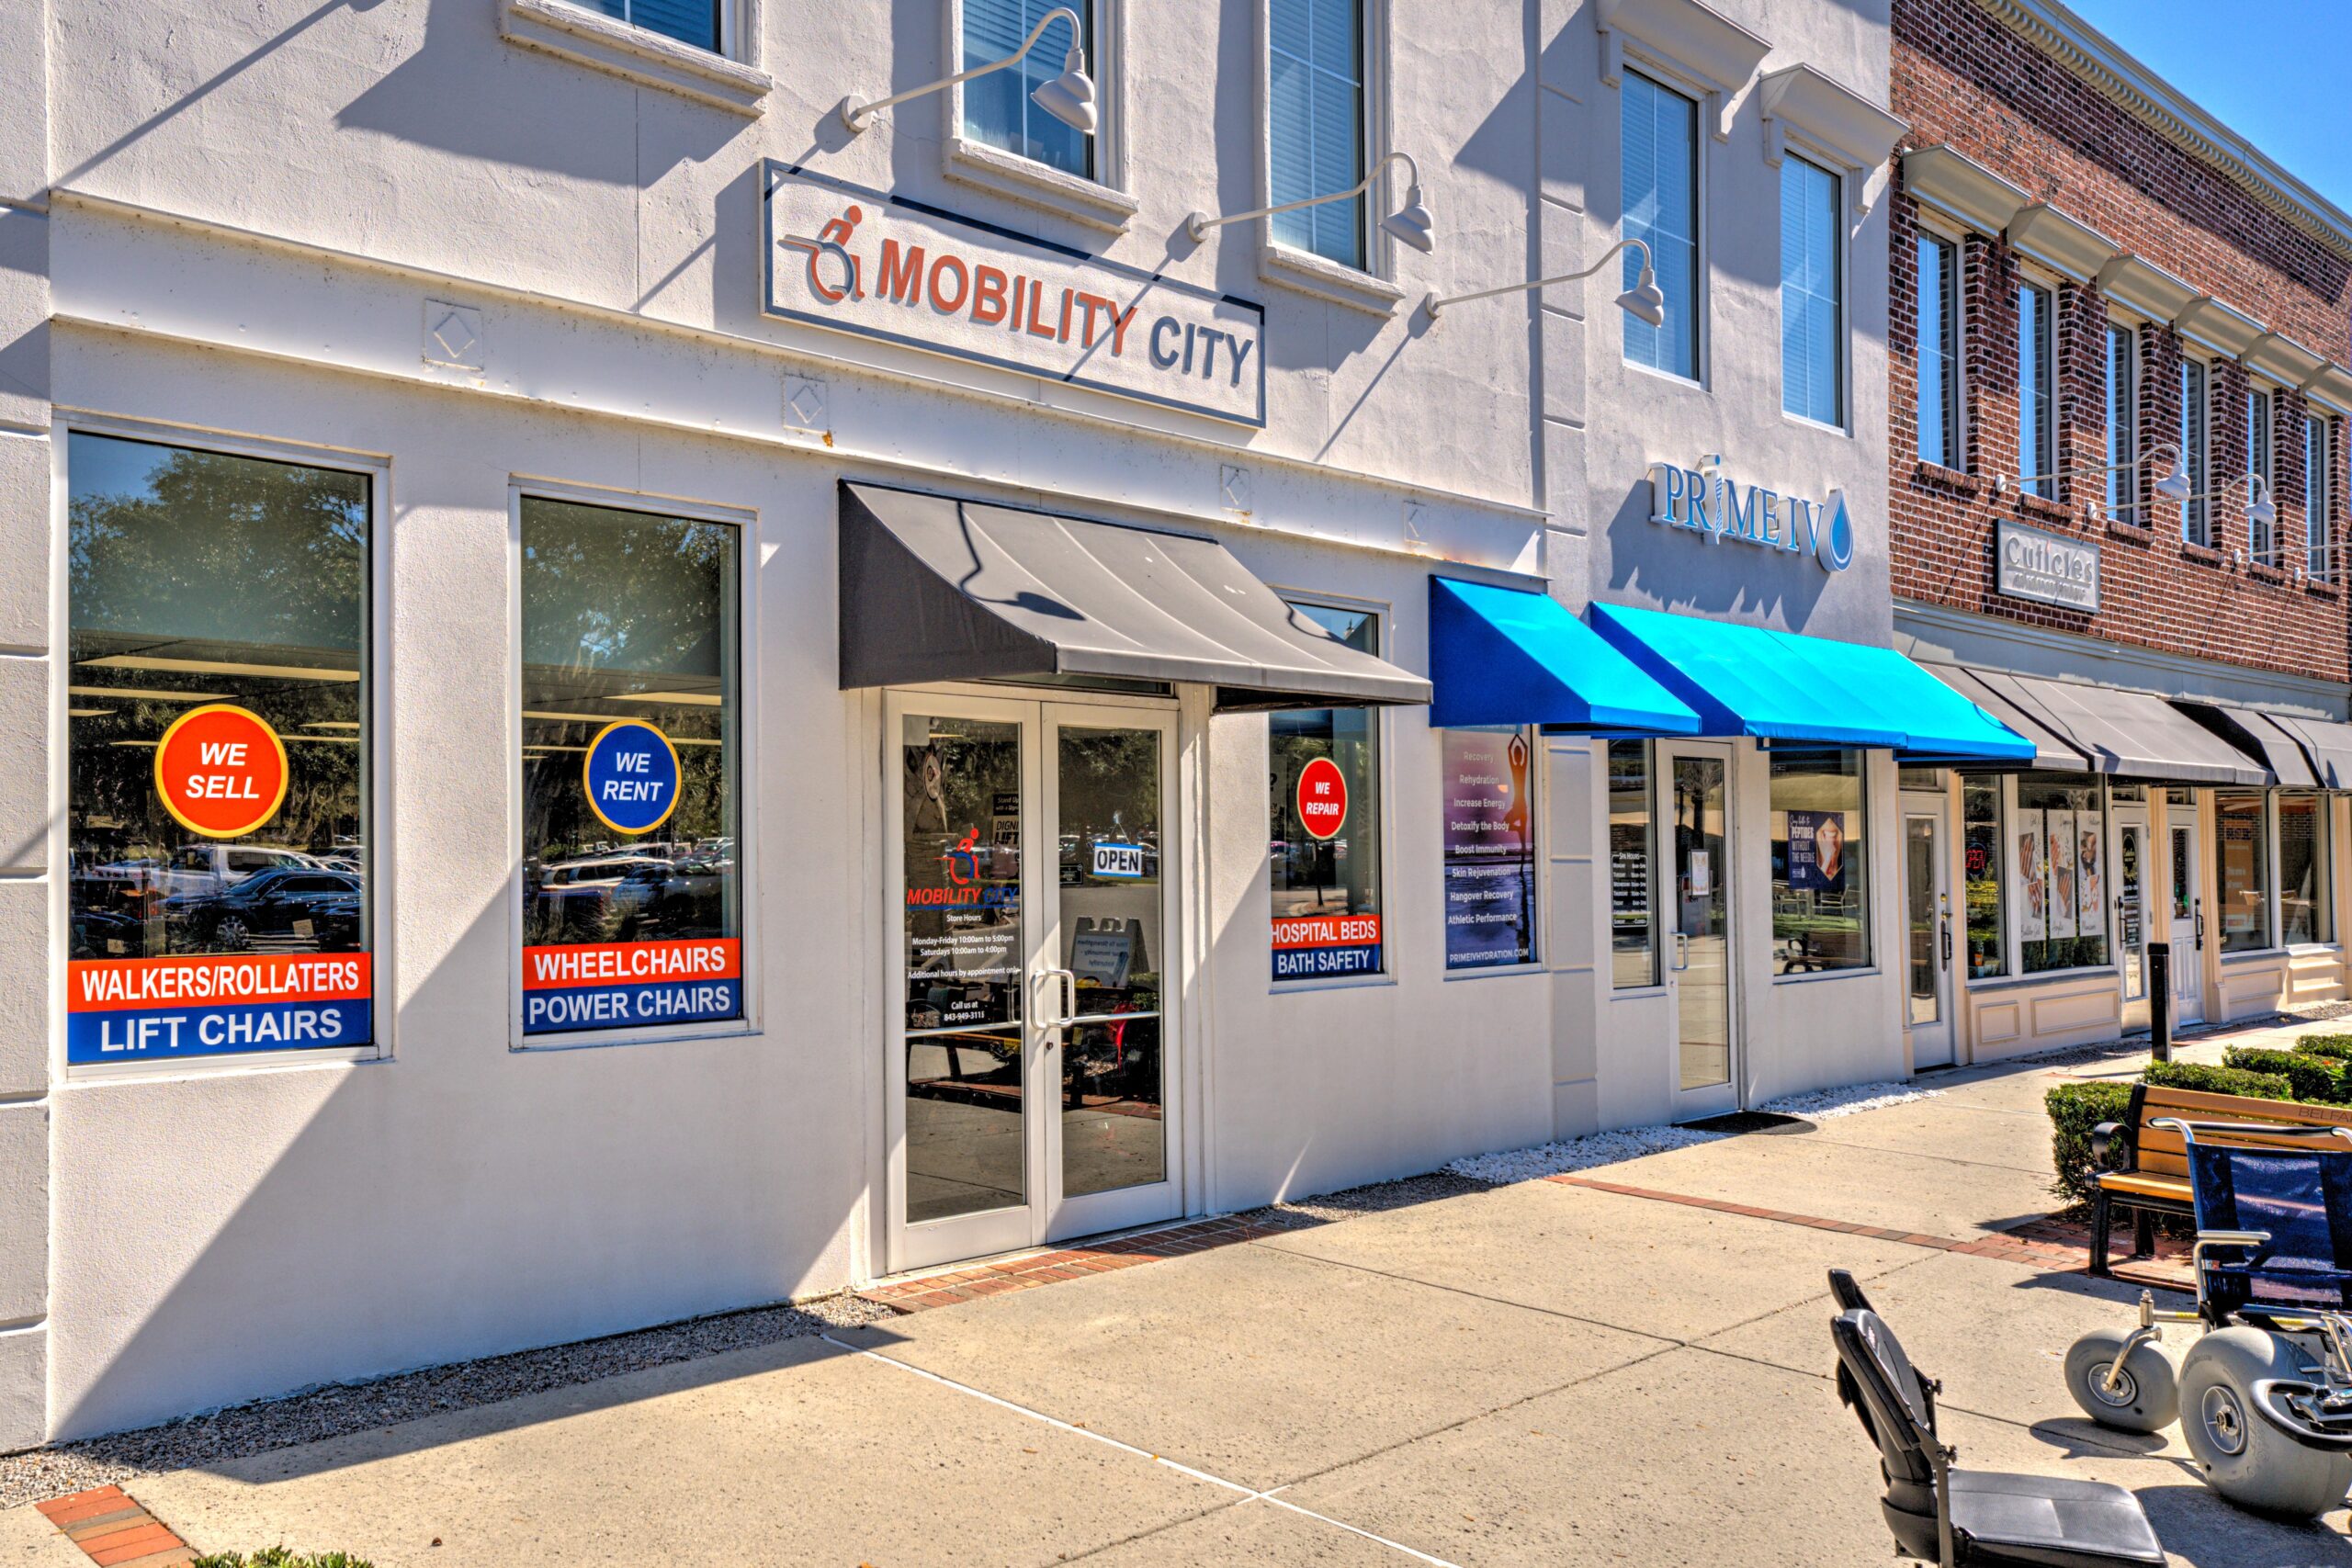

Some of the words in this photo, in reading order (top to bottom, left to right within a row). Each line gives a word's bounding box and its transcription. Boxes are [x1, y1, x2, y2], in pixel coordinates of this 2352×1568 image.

[877, 239, 1138, 356] MOBILITY
[1148, 315, 1253, 387] CITY
[2005, 537, 2093, 582] Cuticles
[199, 742, 249, 768] WE
[615, 751, 651, 773] WE
[1464, 751, 1495, 763] Recovery
[185, 770, 261, 800] SELL
[1459, 774, 1499, 786] Rehydration
[602, 779, 664, 803] RENT
[1314, 782, 1330, 795] WE
[1306, 802, 1340, 817] REPAIR
[1453, 798, 1482, 807] Increase
[1483, 798, 1506, 809] Energy
[1452, 821, 1480, 832] Detoxify
[1480, 821, 1492, 830] the
[1493, 821, 1510, 831] Body
[1455, 845, 1475, 854] Boost
[1476, 844, 1508, 855] Immunity
[1097, 850, 1139, 872] OPEN
[1452, 868, 1467, 878] Skin
[1468, 867, 1511, 879] Rejuvenation
[907, 887, 982, 905] MOBILITY
[984, 886, 1018, 903] CITY
[1450, 891, 1483, 903] Hangover
[1484, 890, 1514, 900] Recovery
[946, 914, 963, 922] Store
[1448, 915, 1475, 925] Athletic
[1476, 912, 1518, 923] Performance
[1272, 921, 1338, 943] HOSPITAL
[1340, 919, 1376, 940] BEDS
[912, 937, 957, 946] Monday-Friday
[992, 935, 1014, 944] 5:00pm
[920, 948, 951, 957] Saturdays
[985, 946, 1007, 954] 4:00pm
[1450, 948, 1529, 963] PRIMEIVHYDRATION.COM
[534, 945, 727, 981] WHEELCHAIRS
[1277, 953, 1314, 974] BATH
[1317, 950, 1370, 970] SAFETY
[908, 970, 940, 979] Additional
[941, 969, 958, 977] hours
[959, 968, 967, 977] by
[967, 967, 1005, 976] appointment
[81, 961, 360, 1002] WALKERS/ROLLATERS
[529, 992, 630, 1025] POWER
[637, 986, 731, 1019] CHAIRS
[100, 1015, 183, 1053] LIFT
[198, 1009, 343, 1046] CHAIRS
[2299, 1107, 2352, 1122] BELFA
